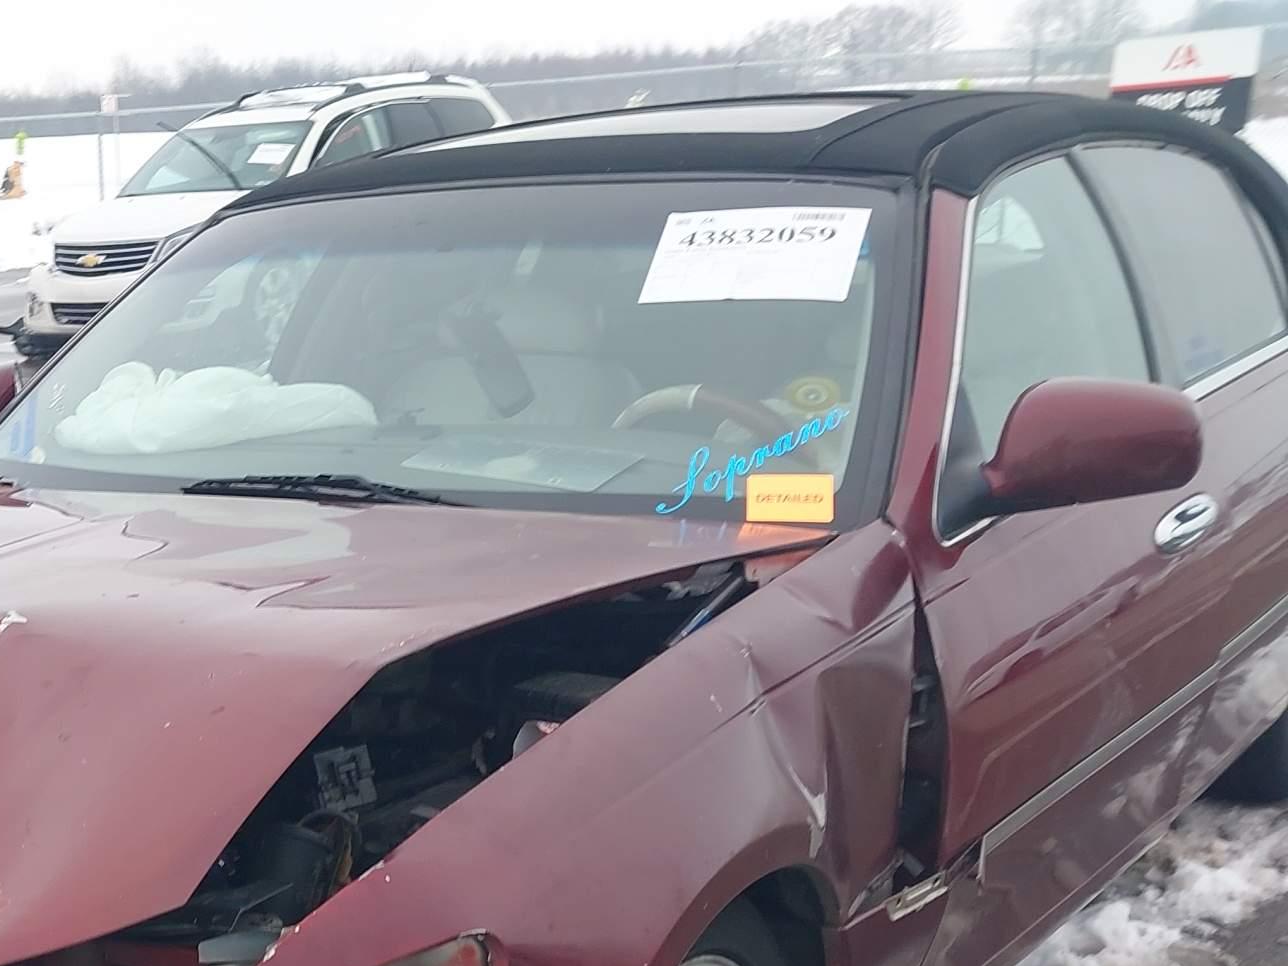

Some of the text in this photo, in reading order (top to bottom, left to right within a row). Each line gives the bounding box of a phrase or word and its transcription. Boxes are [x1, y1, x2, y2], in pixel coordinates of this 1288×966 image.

[678, 227, 837, 247] 43832059
[656, 407, 850, 514] Soprano
[755, 492, 825, 504] DETAILED
